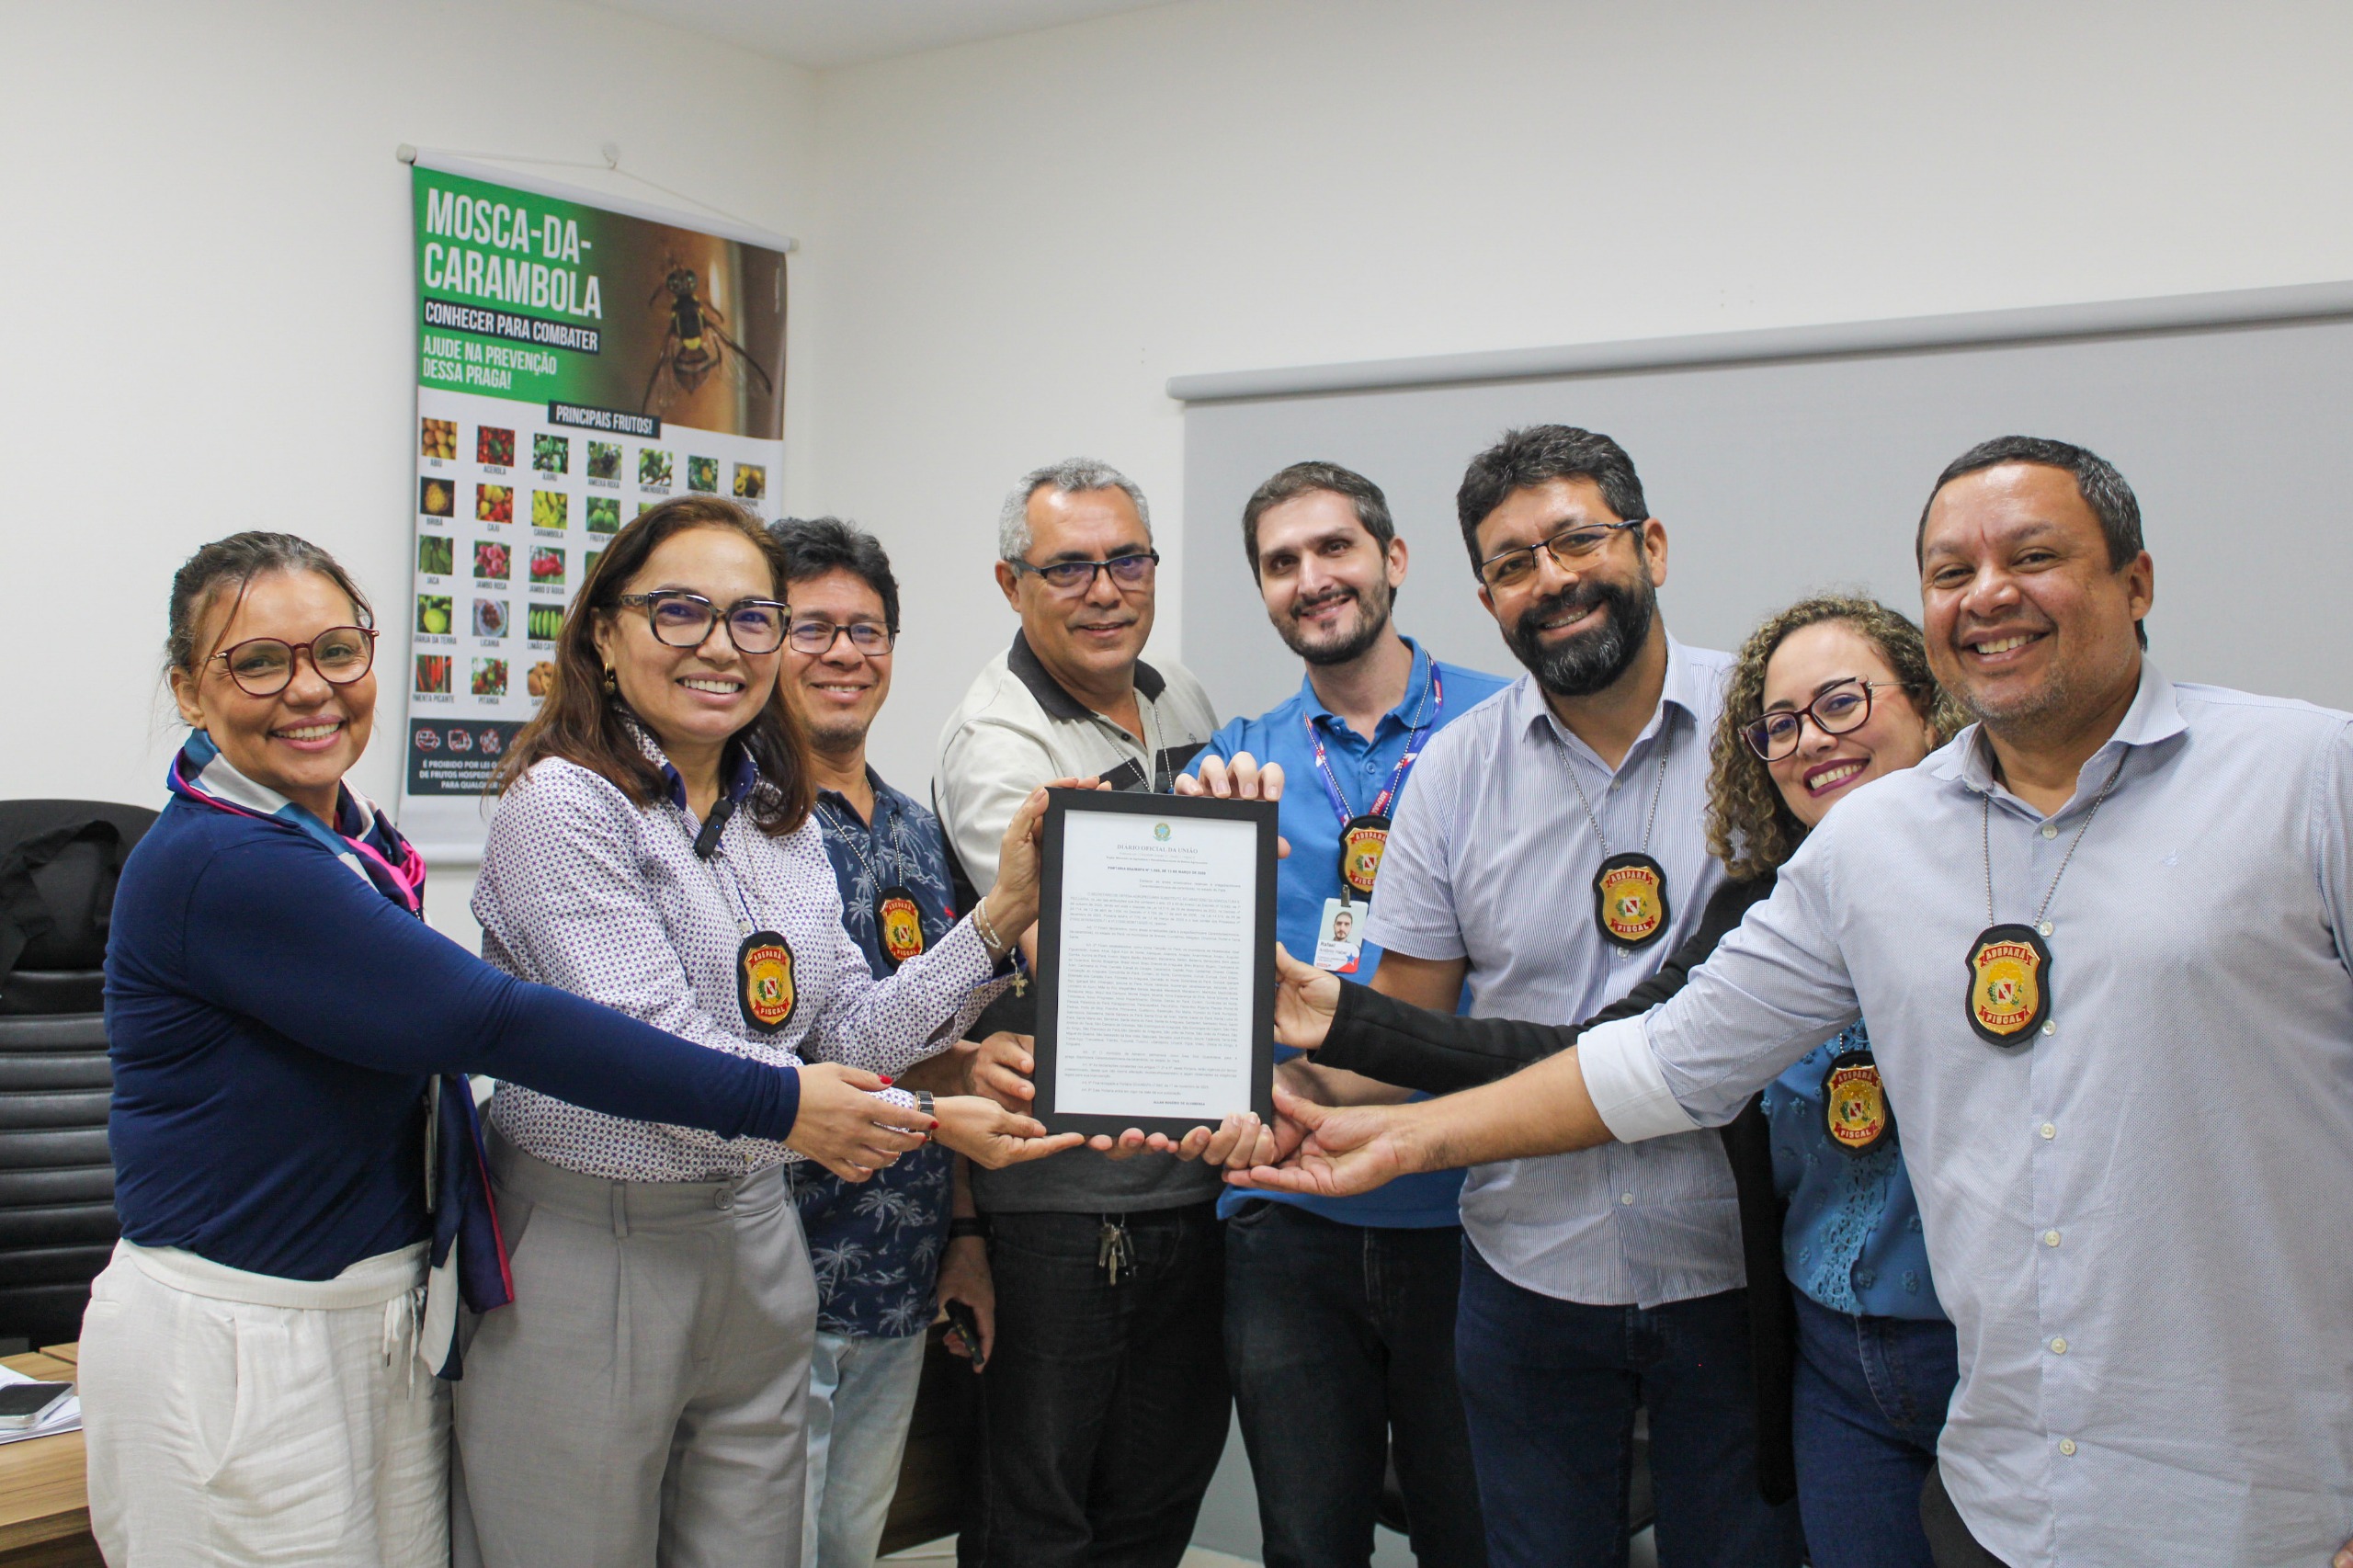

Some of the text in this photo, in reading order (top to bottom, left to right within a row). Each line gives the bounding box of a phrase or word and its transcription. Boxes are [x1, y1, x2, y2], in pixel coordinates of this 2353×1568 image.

[426, 187, 592, 265] MOSCA-DA-
[424, 243, 602, 319] CARAMBOLA
[425, 301, 598, 351] CONHECER PARA COMBATER
[424, 335, 557, 377] AJUDE NA PREVENÇÃO
[423, 358, 511, 390] DESSA PRAGA!
[555, 405, 654, 435] PRINCIPAIS FRUTOS!
[483, 465, 506, 475] ACEROLA
[487, 523, 500, 532] CAJU
[534, 528, 564, 539] CARAMBOLA
[428, 760, 463, 768] PROIBIDO
[419, 770, 429, 778] DE
[430, 770, 457, 778] FRUTOS
[1141, 845, 1165, 853] OFICIAL
[1618, 922, 1649, 932] FISCAL
[760, 1006, 787, 1016] FISCAL
[1985, 1014, 2022, 1024] FISCAL
[1840, 1129, 1872, 1139] FISCAL
